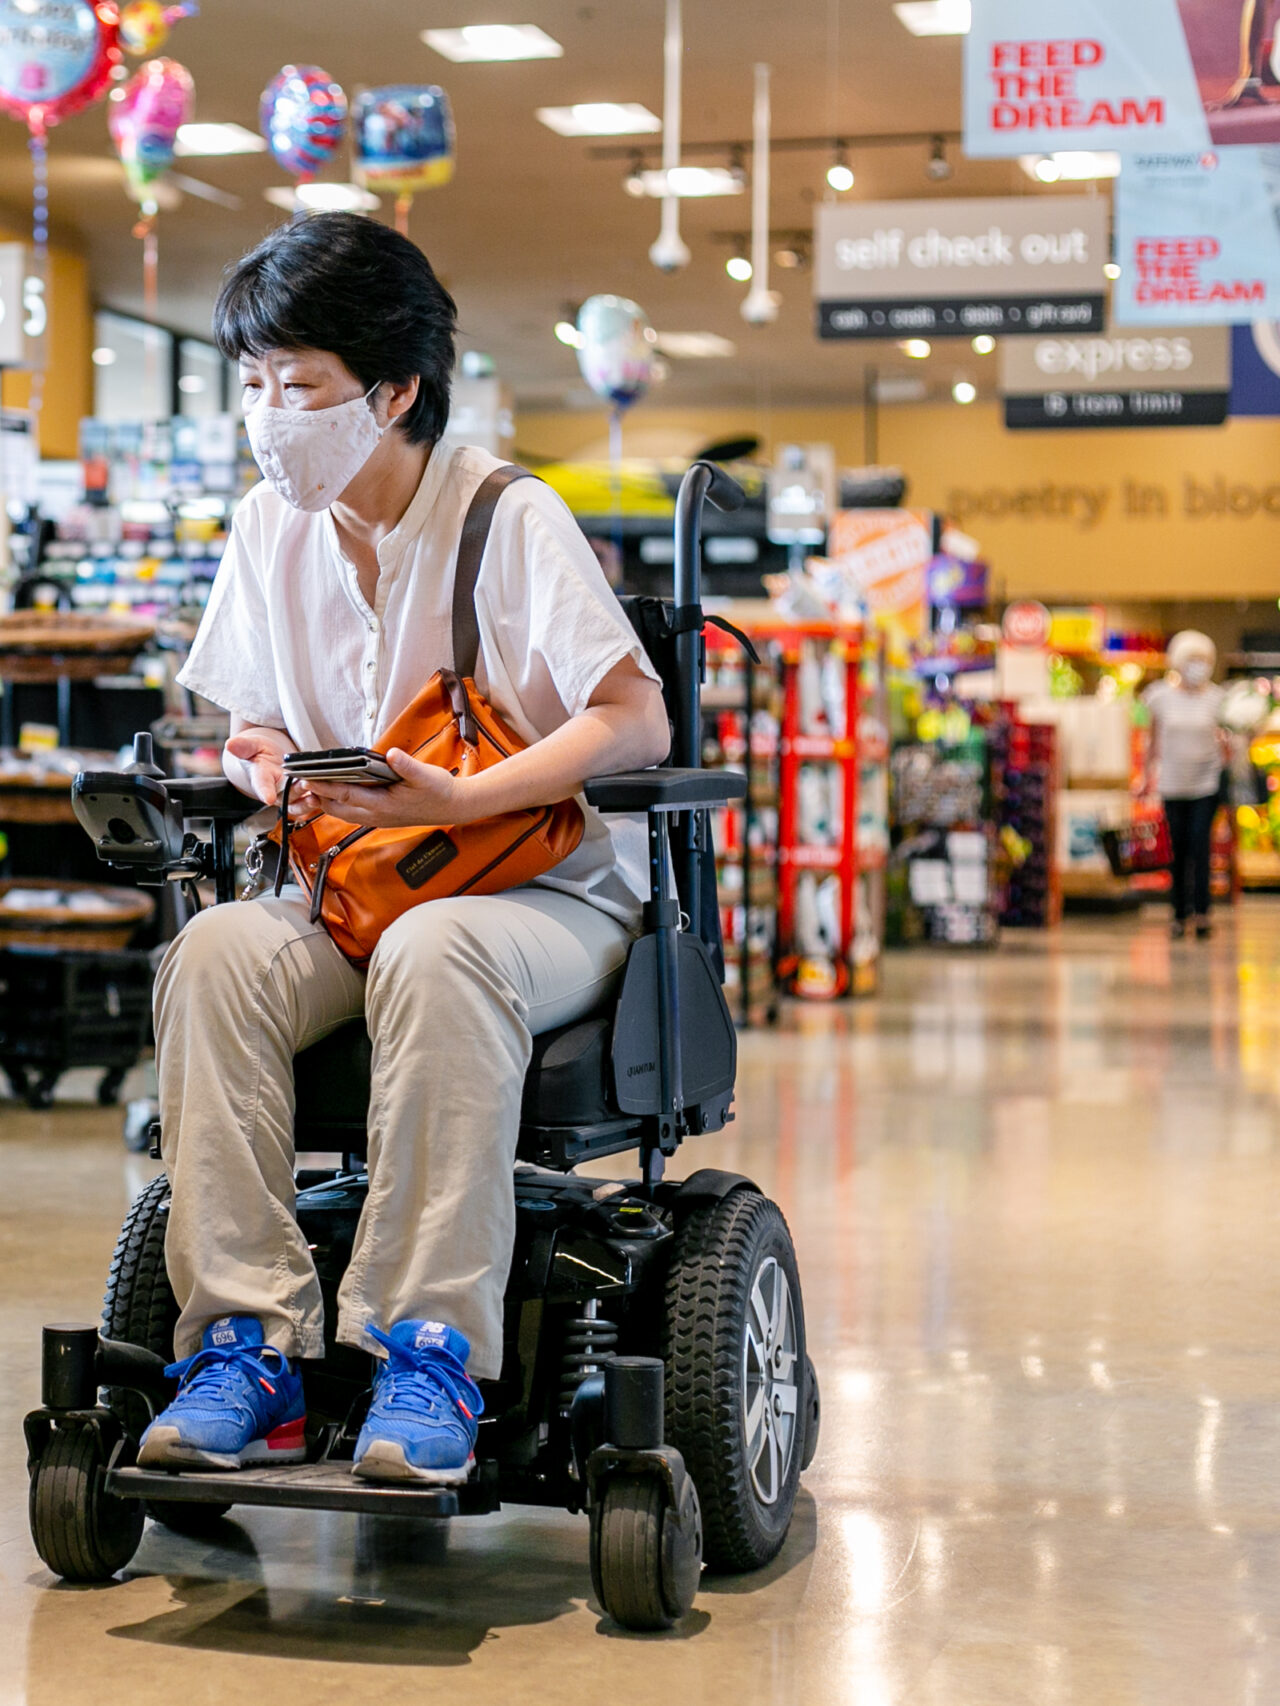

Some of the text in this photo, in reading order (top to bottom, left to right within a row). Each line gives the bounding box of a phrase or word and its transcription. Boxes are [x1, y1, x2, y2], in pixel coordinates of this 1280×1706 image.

[991, 39, 1105, 69] FEED
[990, 69, 1076, 99] THE
[990, 97, 1166, 132] DREAM
[835, 227, 1088, 270] self check out
[1134, 237, 1222, 260] FEED
[1134, 259, 1200, 280] THE
[1134, 280, 1266, 307] DREAM
[1035, 337, 1193, 382] express
[947, 481, 1110, 533] poetry
[1121, 475, 1168, 519] in
[216, 1332, 234, 1344] 696
